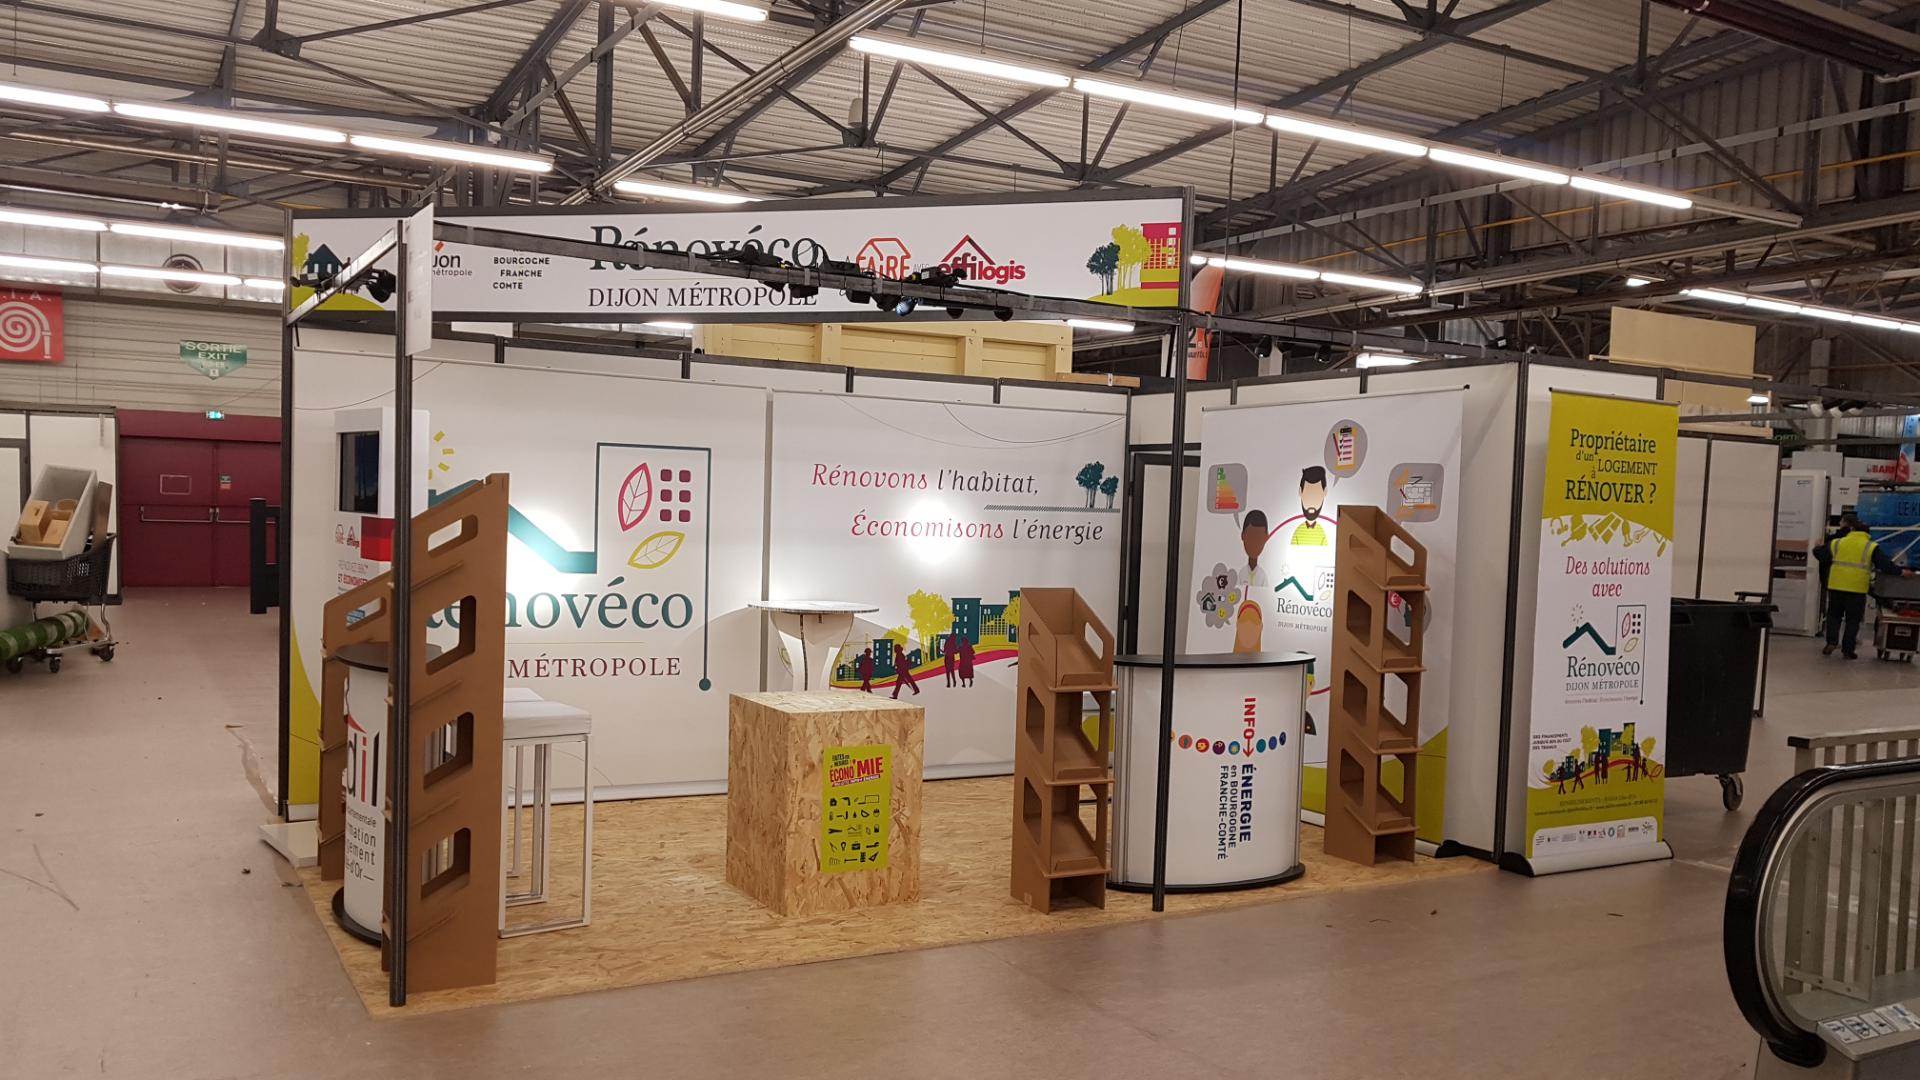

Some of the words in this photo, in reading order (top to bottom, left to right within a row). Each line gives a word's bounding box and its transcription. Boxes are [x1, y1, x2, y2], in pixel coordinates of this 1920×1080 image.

[493, 256, 551, 265] BOURGOGNE
[432, 268, 473, 277] étropole
[500, 269, 543, 277] FRANCHE
[588, 287, 659, 307] DIJON
[185, 341, 242, 353] SORTIE
[198, 352, 229, 360] EXIT
[1570, 428, 1656, 454] Propriétaire
[1576, 451, 1594, 461] d'un
[1598, 459, 1658, 475] LOGEMENT
[811, 463, 928, 490] Rénovons
[937, 469, 1039, 494] l'habitat,
[1565, 474, 1645, 504] RÉNOVER
[1649, 482, 1657, 504] ?
[851, 509, 1004, 539] Économisons
[1013, 519, 1103, 545] l'énergie
[1565, 556, 1588, 575] Des
[1591, 557, 1650, 575] solutions
[1592, 583, 1622, 597] avec
[428, 576, 693, 629] novéco
[1277, 598, 1333, 618] Rénovéco
[507, 653, 681, 678] MÉTROPOLE
[1566, 655, 1640, 677] Rénovéco
[1565, 681, 1590, 691] DIJON
[1591, 678, 1639, 690] MÉTROPOLE
[1243, 697, 1256, 740] INFO
[1230, 765, 1237, 778] en
[1217, 765, 1229, 860] FRANCHE-COMTÉ
[1239, 763, 1257, 842] ÉNERGIE
[1228, 780, 1238, 848] BOURGOGNE
